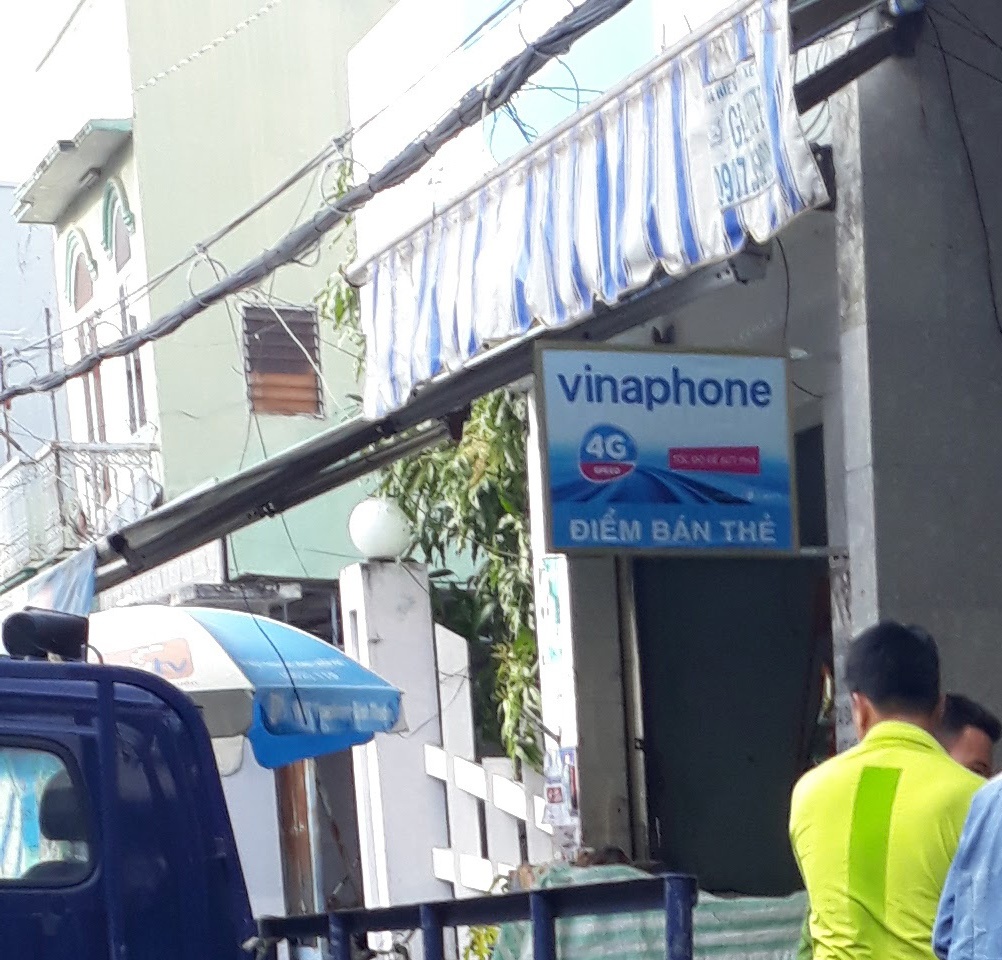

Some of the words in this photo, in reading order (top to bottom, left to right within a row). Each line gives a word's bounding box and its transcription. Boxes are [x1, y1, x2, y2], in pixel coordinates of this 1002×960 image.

[558, 364, 772, 412] vinaphone
[585, 433, 629, 460] 4G
[569, 507, 642, 542] ĐIỂM
[652, 514, 710, 543] BÁN
[720, 513, 777, 543] THẺ
